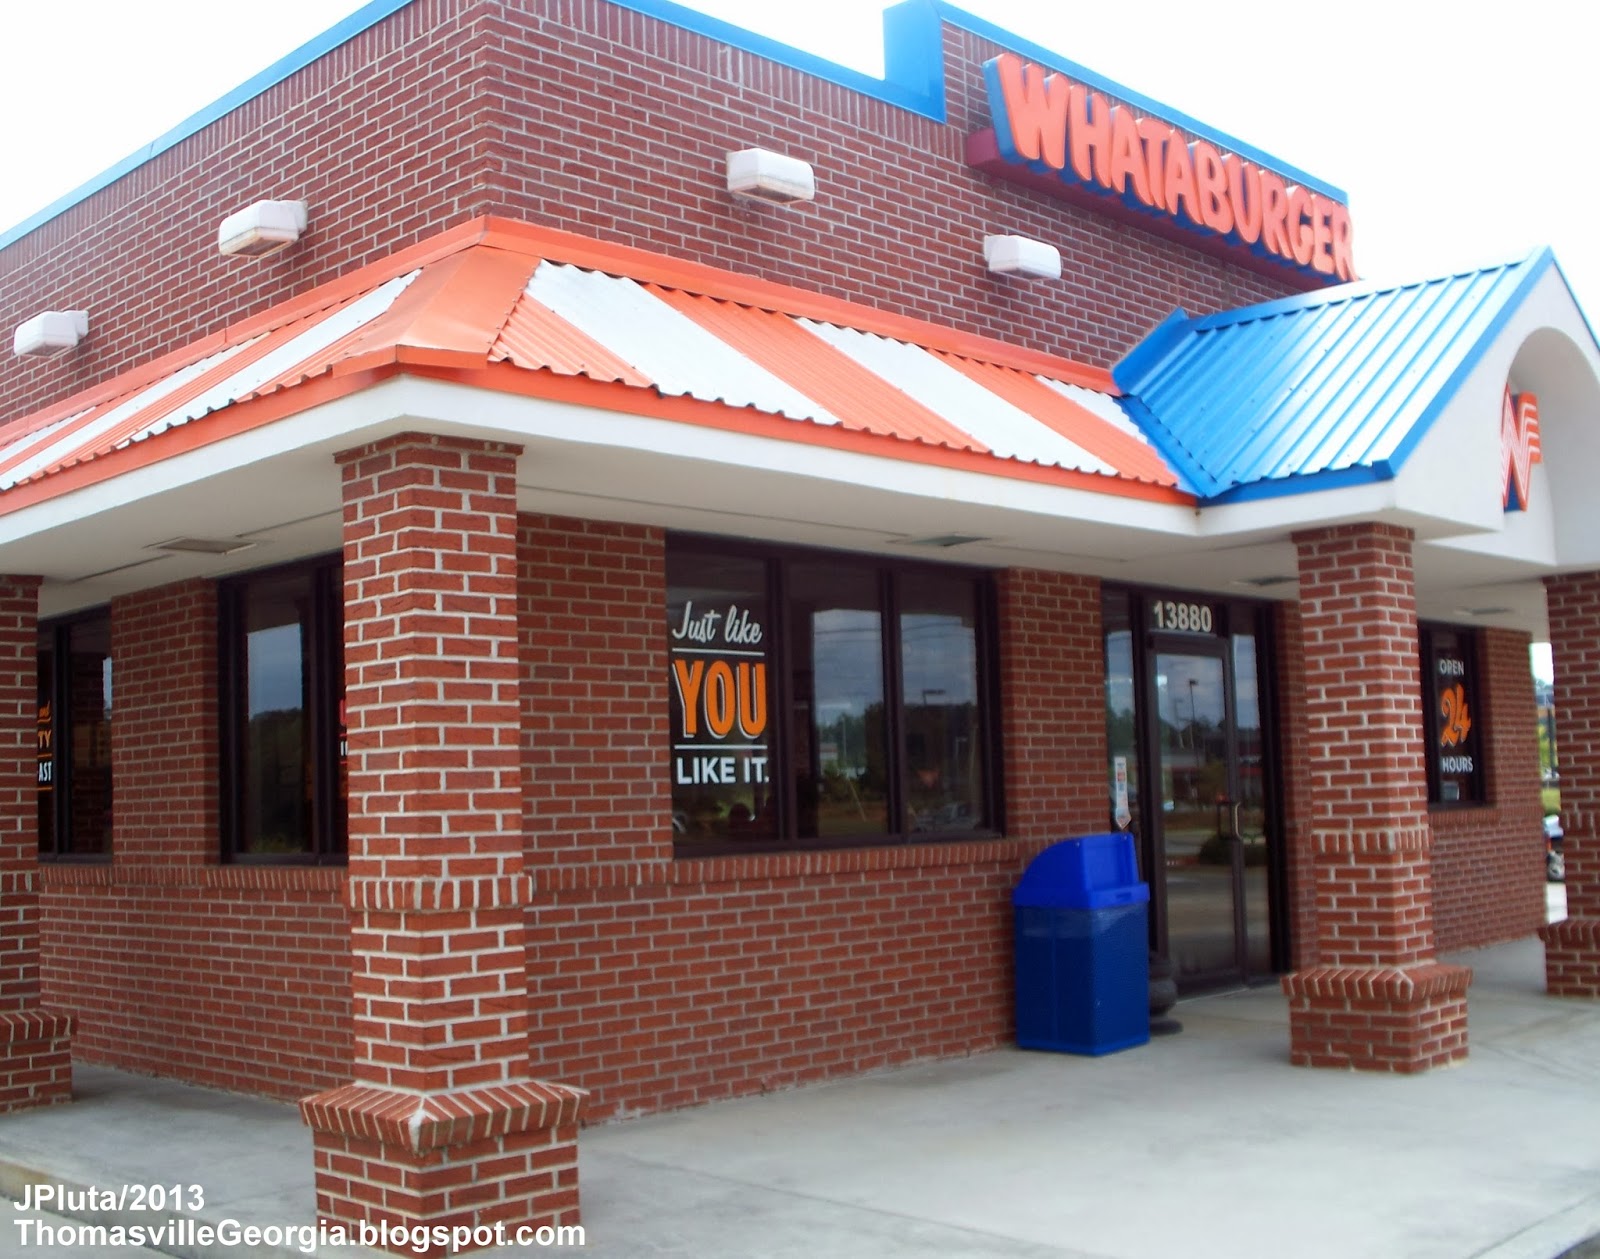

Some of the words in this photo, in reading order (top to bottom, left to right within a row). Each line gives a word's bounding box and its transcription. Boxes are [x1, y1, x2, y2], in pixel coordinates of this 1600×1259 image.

[984, 53, 1356, 283] WHATABURGER
[672, 601, 721, 643] Just
[725, 605, 763, 644] like
[1154, 601, 1212, 633] 13880
[1439, 659, 1464, 675] OPEN
[672, 660, 767, 739] YOU
[1441, 683, 1472, 747] 24
[677, 757, 736, 785] LIKE
[744, 757, 770, 783] IT.
[1442, 756, 1473, 773] HOURS
